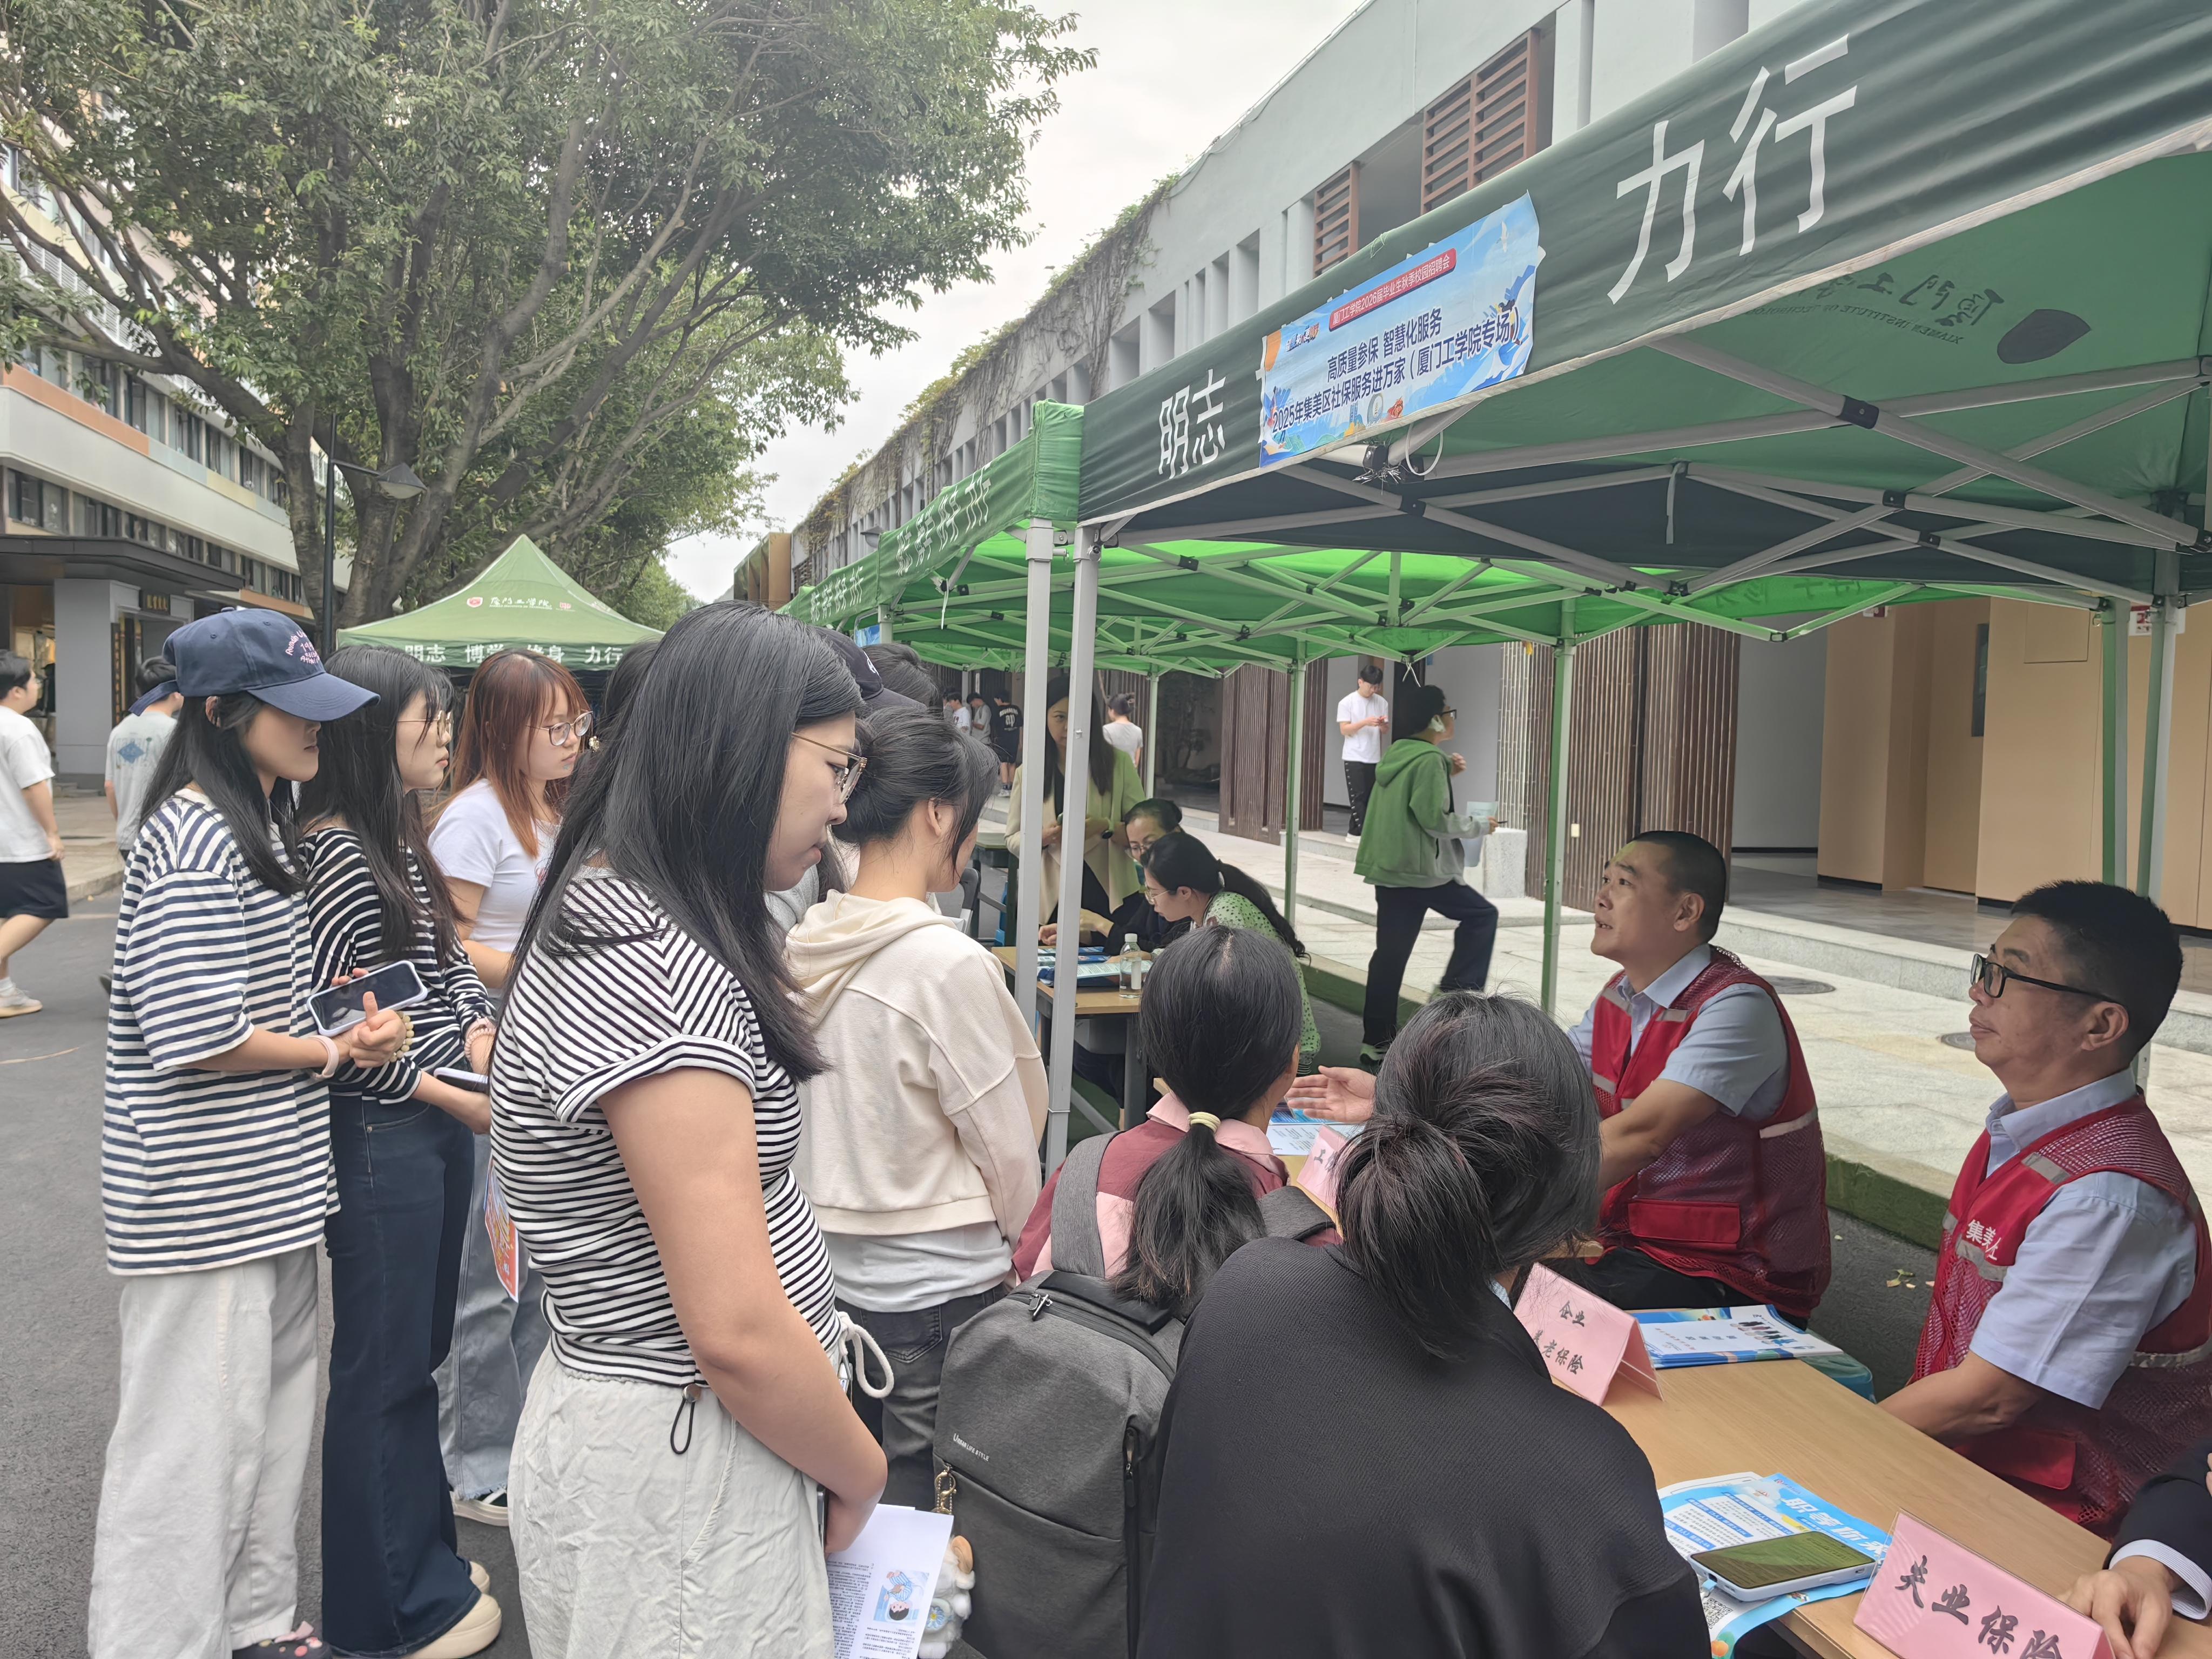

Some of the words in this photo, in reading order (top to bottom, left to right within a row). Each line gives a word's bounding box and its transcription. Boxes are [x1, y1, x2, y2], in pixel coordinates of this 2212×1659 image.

[1607, 33, 1858, 305] 力行
[1333, 254, 1451, 325] 厦门工学院2026届毕业生秋季校园招聘会
[1327, 336, 1379, 384] 高质量参保
[1383, 308, 1443, 358] 智慧化服务
[1158, 368, 1226, 480] 明志
[405, 644, 446, 663] 明志
[585, 646, 623, 664] 力行
[1559, 1300, 1585, 1327] 企业
[966, 1444, 976, 1454] LIFE
[975, 1449, 990, 1462] STYLE
